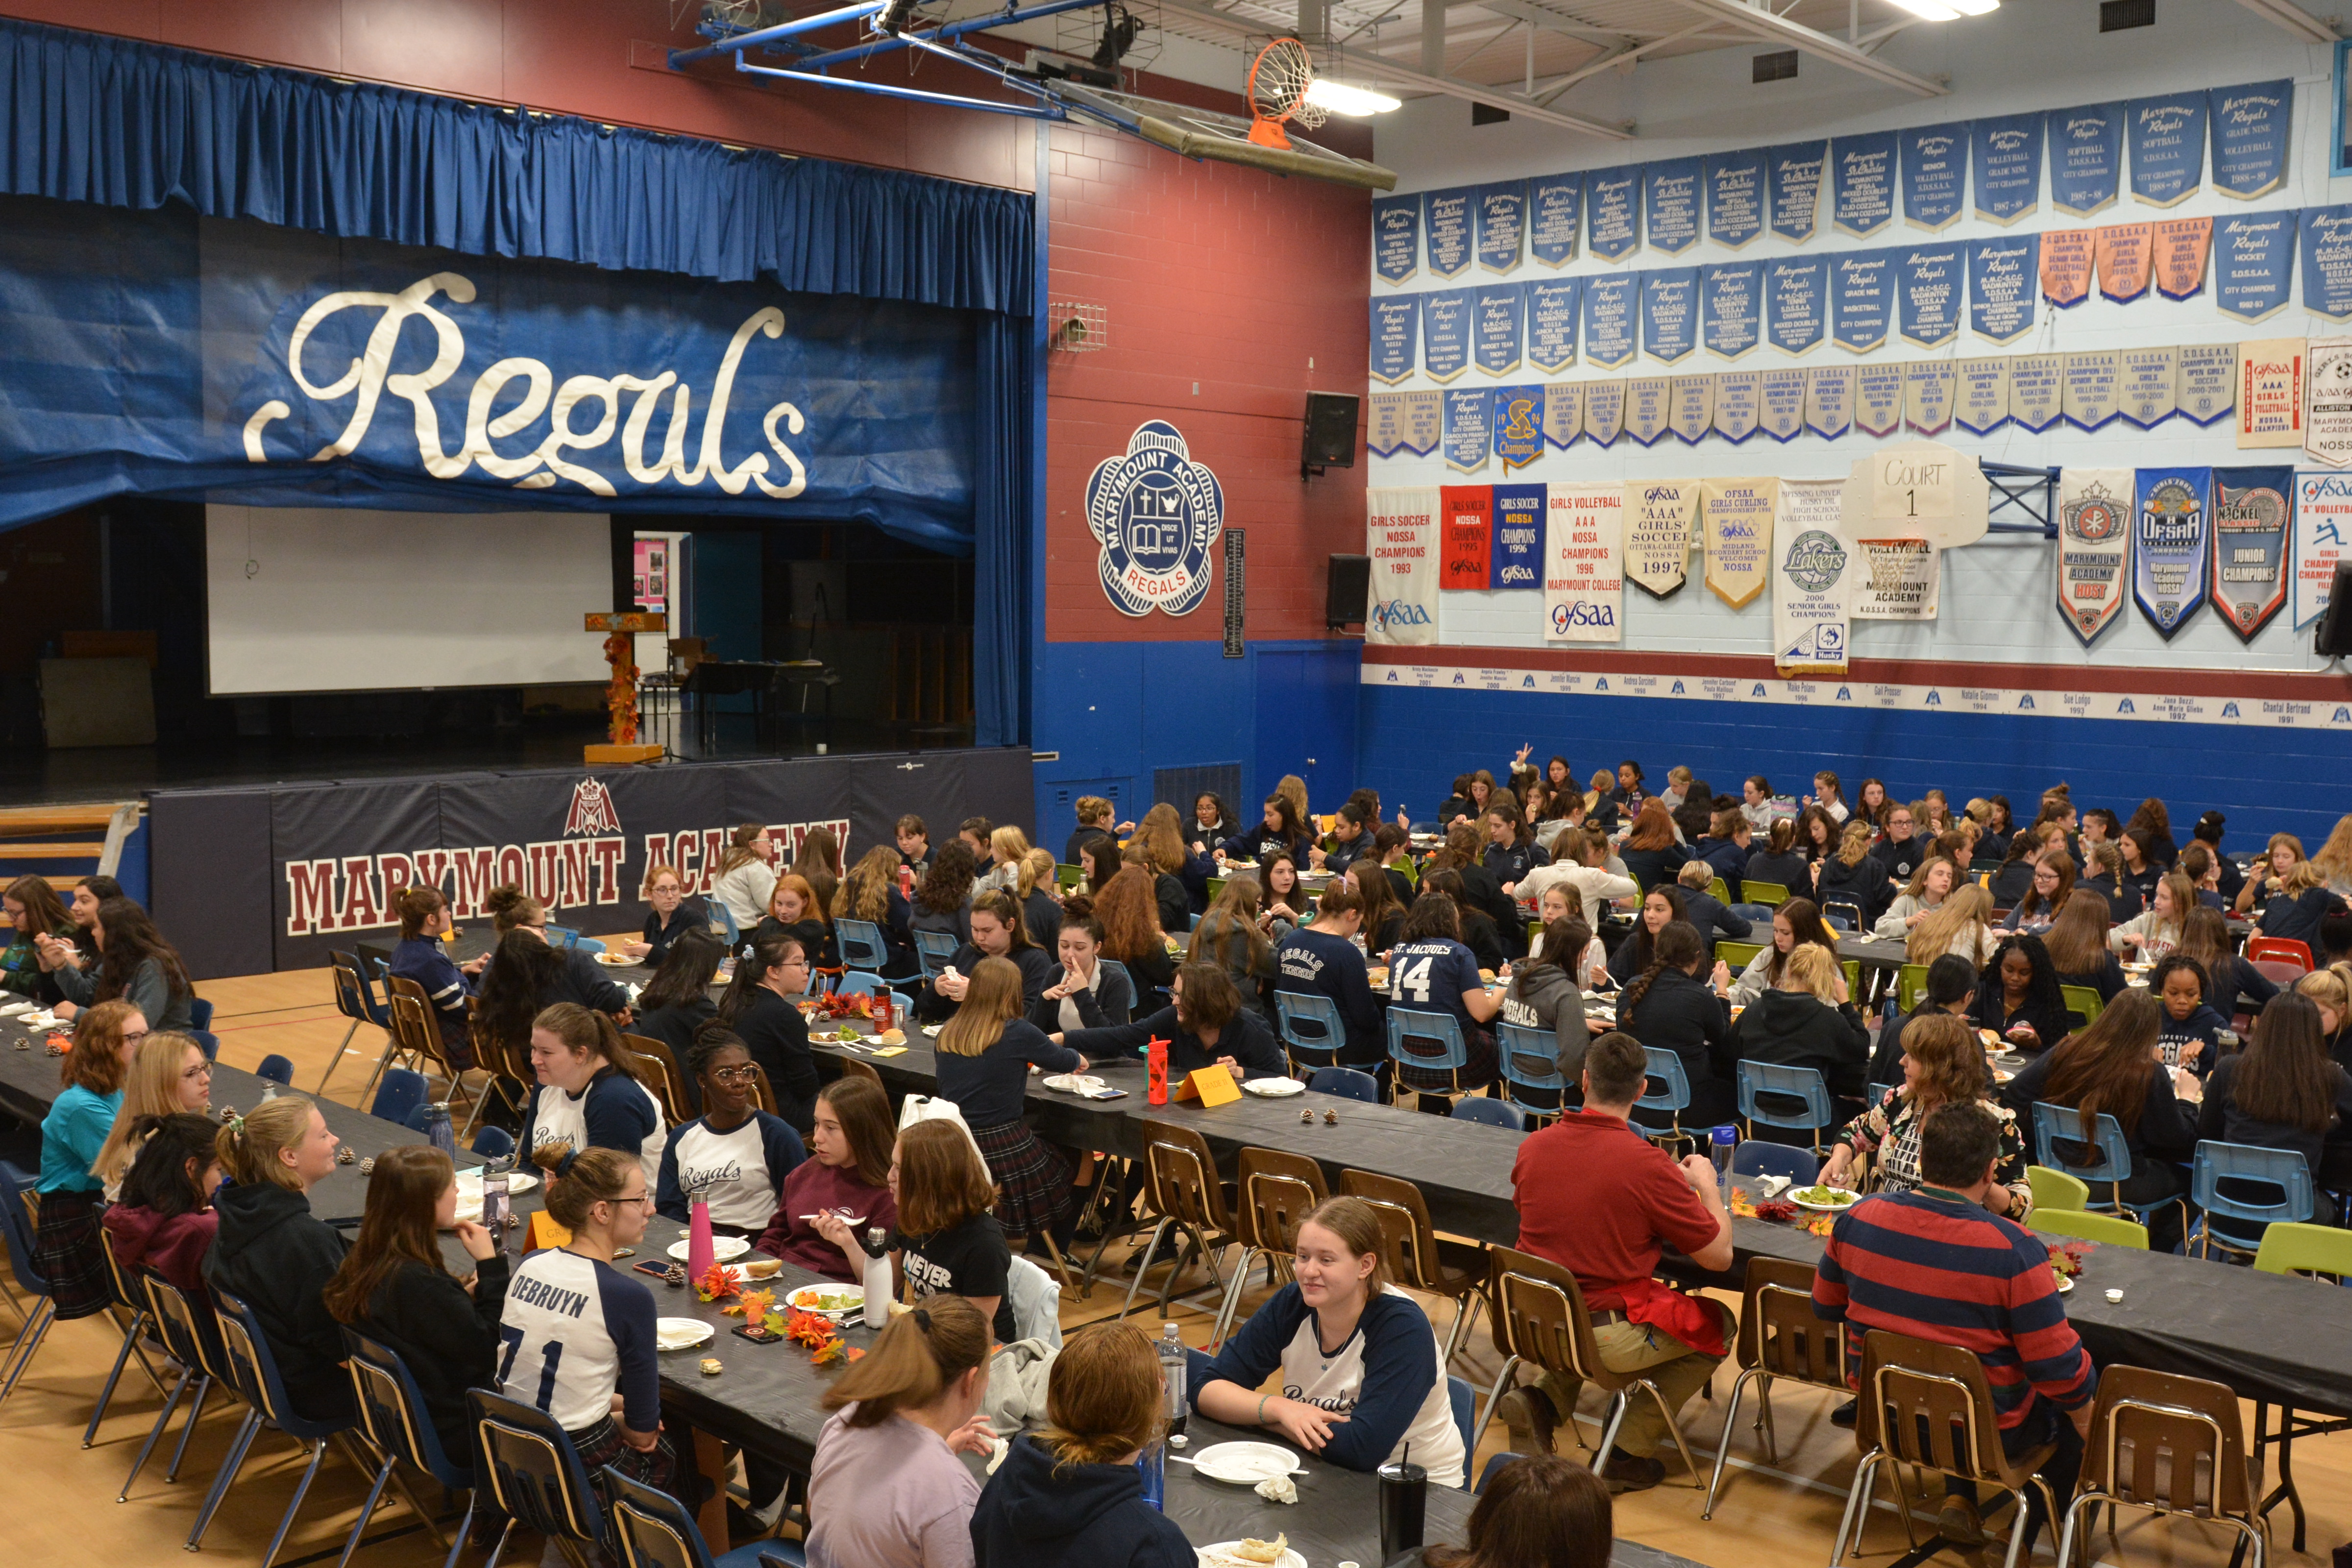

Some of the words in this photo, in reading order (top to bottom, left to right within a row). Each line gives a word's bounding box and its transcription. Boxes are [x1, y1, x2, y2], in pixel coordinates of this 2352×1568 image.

[2227, 127, 2250, 138] GRADE
[2253, 124, 2271, 133] NINE
[2143, 136, 2182, 149] SOFTBALL
[2225, 142, 2273, 155] VOLLEYBALL
[2225, 220, 2280, 235] Marymount
[2232, 236, 2269, 252] Regals
[2235, 253, 2266, 262] HOCKEY
[1841, 259, 1885, 271] Marymount
[1848, 273, 1877, 285] Regals
[243, 272, 806, 499] Regals
[2255, 403, 2290, 414] VOLLEYBALL
[1499, 441, 1535, 454] Champions
[1725, 489, 1754, 498] OFSAA
[1105, 451, 1168, 549] MARYMOUNT
[1173, 462, 1206, 554] ACADEMY
[1500, 498, 1516, 510] GIRLS
[1517, 497, 1539, 509] SOCCER
[1550, 498, 1572, 509] GIRLS
[1574, 497, 1621, 508] VOLLEYBALL
[1711, 499, 1732, 508] GIRLS
[1734, 498, 1768, 507] CURLING
[1907, 489, 1918, 516] 1
[1371, 515, 1395, 527] GIRLS
[1397, 514, 1430, 526] SOCCER
[1455, 515, 1481, 525] NOSSA
[1506, 514, 1532, 524] NOSSA
[2143, 511, 2200, 539] OFSAA
[1161, 524, 1178, 532] DISCE
[1386, 531, 1416, 542] NOSSA
[1501, 528, 1536, 544] CHAMPIONS
[1572, 532, 1597, 543] NOSSA
[1374, 547, 1425, 558] CHAMPIONS
[1458, 542, 1477, 551] 1995
[1509, 544, 1527, 553] 1996
[1562, 548, 1609, 559] CHAMPIONS
[1783, 542, 1847, 576] Lakers
[2065, 553, 2122, 564] MARYMOUNT
[2233, 548, 2265, 563] JUNIOR
[1391, 563, 1411, 574] 1993
[1576, 564, 1594, 574] 1996
[1642, 562, 1681, 574] 1997
[1723, 563, 1753, 571] NOSSA
[2150, 563, 2190, 573] Marymount
[2070, 568, 2114, 580] ACADEMY
[2153, 574, 2185, 584] Academy
[2223, 567, 2275, 582] CHAMPIONS
[1127, 569, 1186, 595] REGALS
[1547, 579, 1590, 590] MARYMOUNT
[1592, 579, 1620, 590] COLLEGE
[2075, 583, 2107, 599] HOST
[2157, 584, 2180, 594] NOSSA
[1875, 592, 1921, 602] ACADEMY
[1818, 652, 1840, 660] Husky
[2064, 693, 2074, 704] Sue
[2263, 702, 2284, 713] Chantal
[2286, 703, 2311, 714] Bertrand
[1393, 944, 1405, 954] ST.
[1406, 944, 1452, 956] JACQUES
[1280, 949, 1324, 972] REGALS
[1281, 964, 1316, 981] TENNIS
[1391, 956, 1433, 1002] 14
[1503, 997, 1538, 1027] REGALS
[681, 1159, 741, 1189] Regals
[903, 1250, 952, 1288] NEVER
[511, 1275, 589, 1319] DEBRUYN
[495, 1322, 564, 1416] 71
